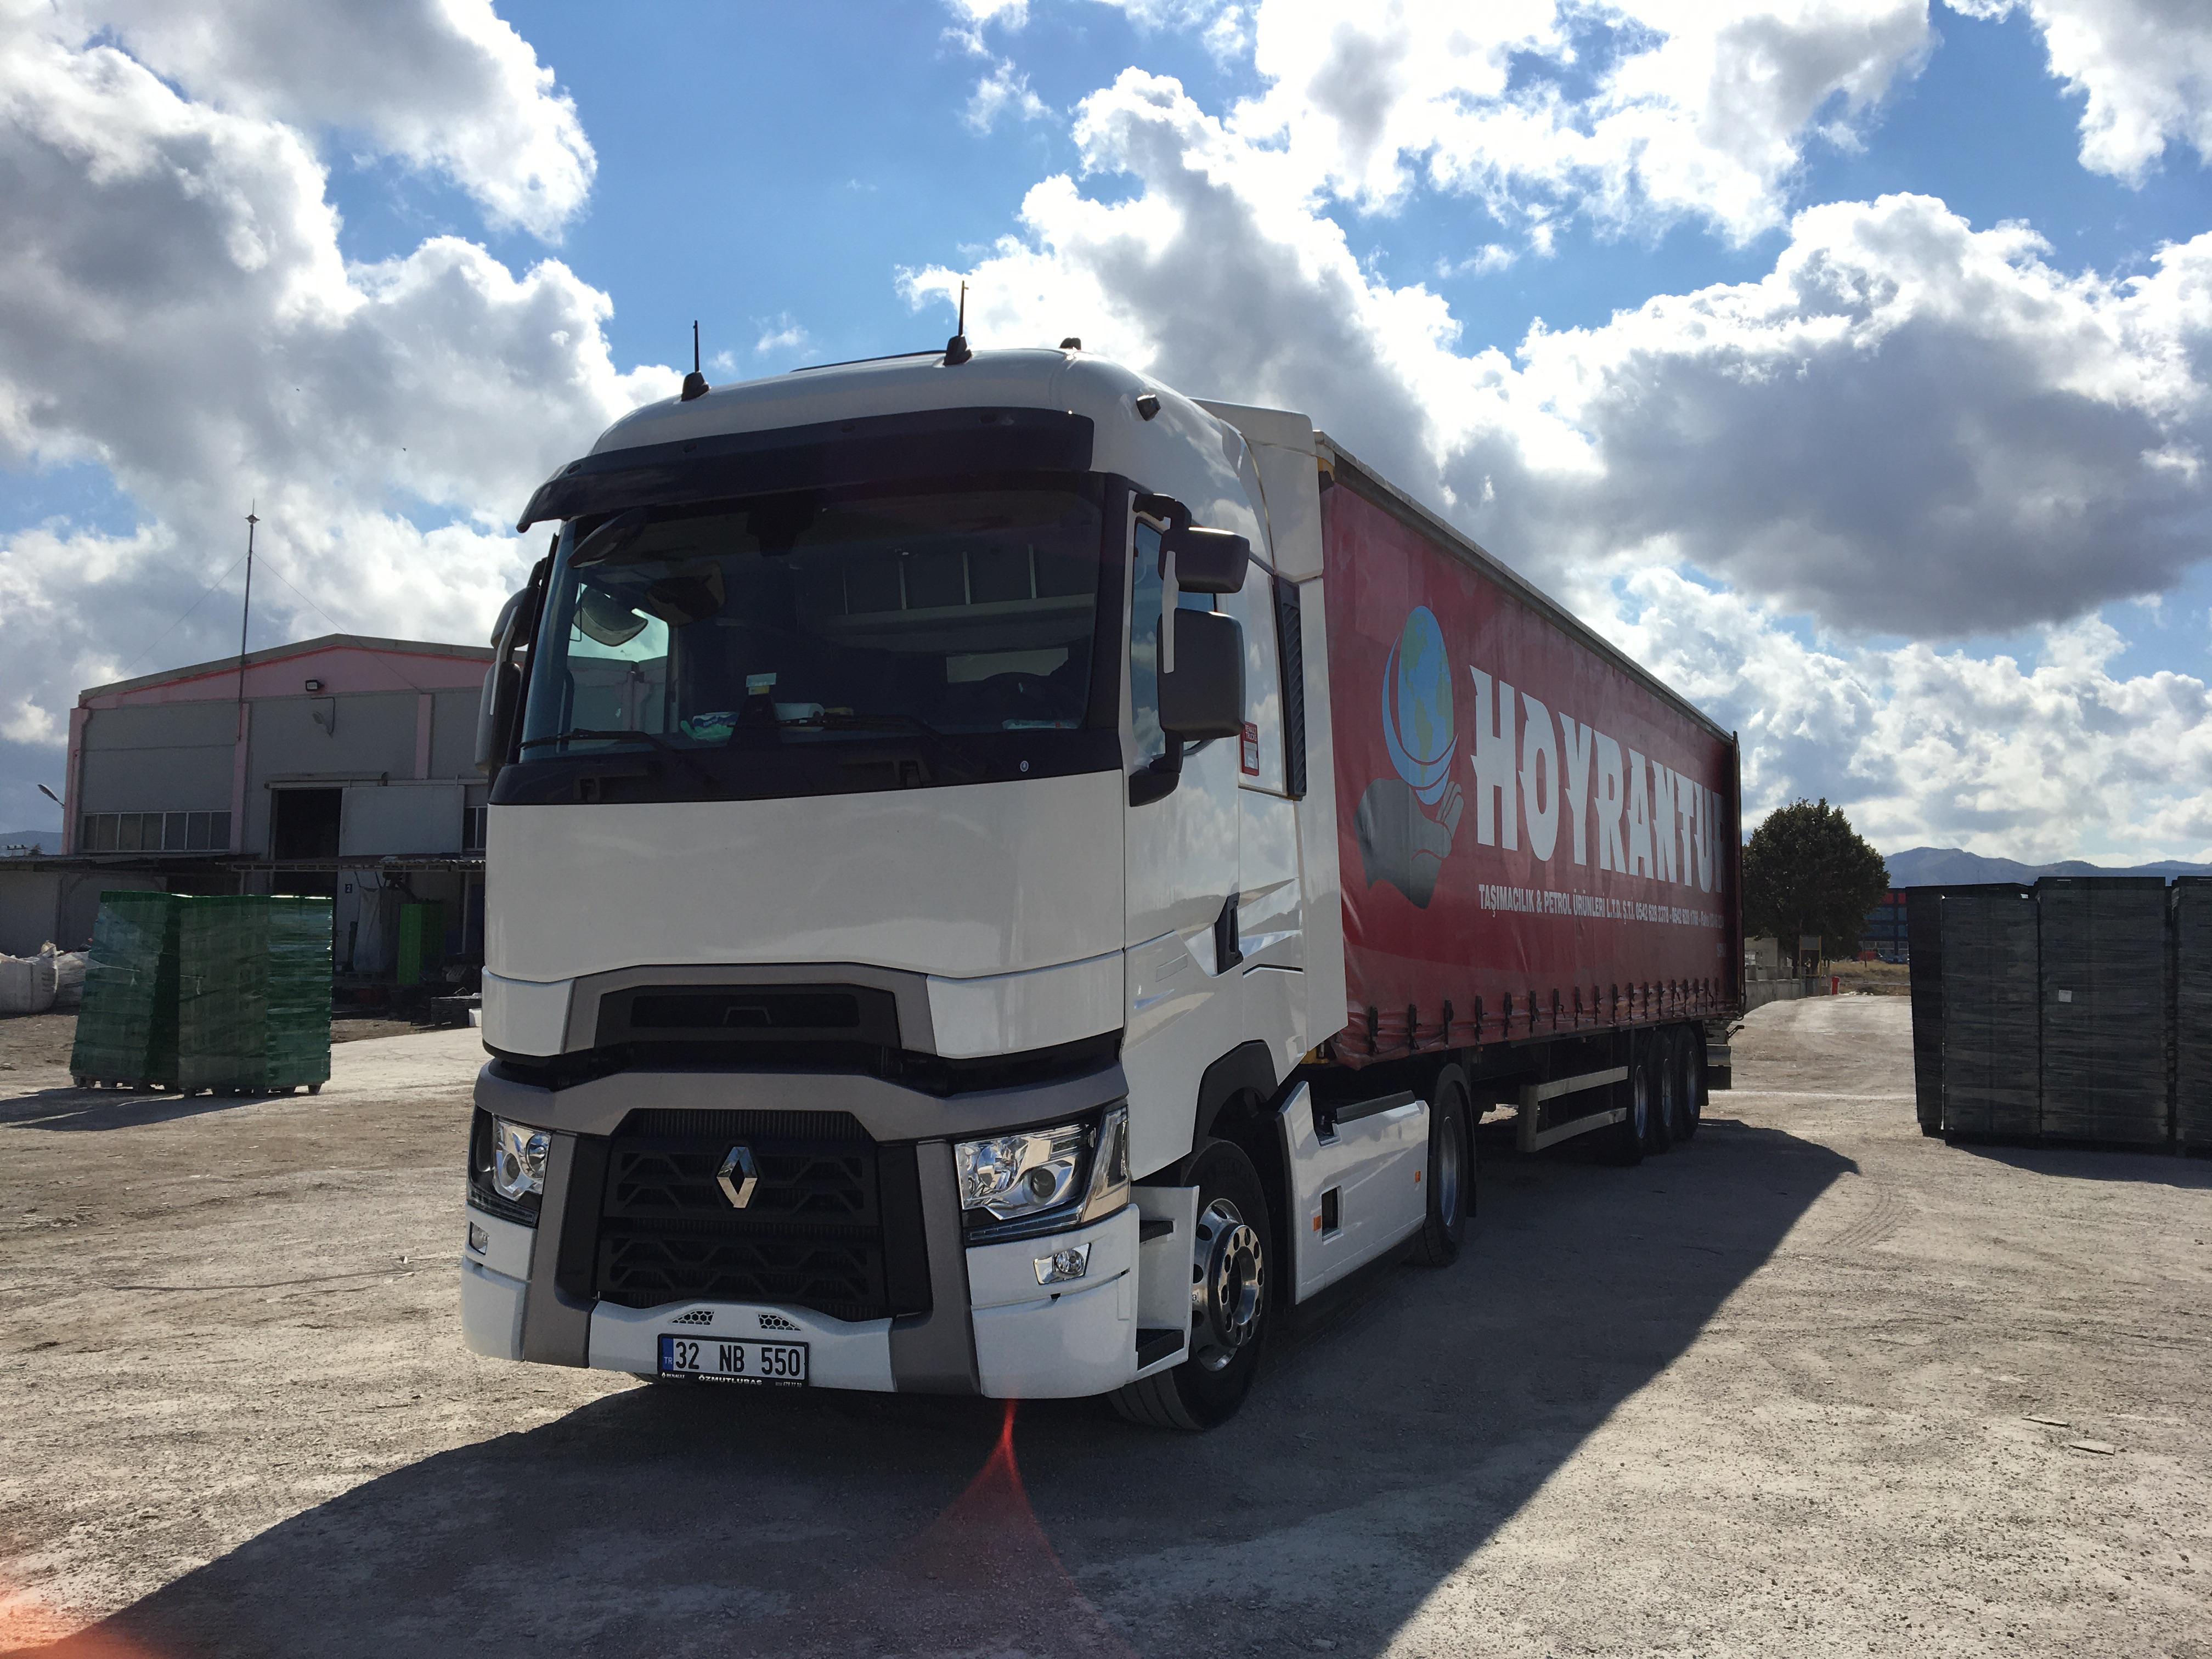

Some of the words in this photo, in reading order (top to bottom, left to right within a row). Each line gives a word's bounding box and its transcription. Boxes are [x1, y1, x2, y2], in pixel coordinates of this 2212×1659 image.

[346, 884, 351, 893] 2
[1479, 884, 1535, 918] TAŞIMACILIK
[1537, 889, 1543, 913] &
[1544, 890, 1572, 915] PETROL
[1572, 888, 1606, 918] ÜRÜNLERİ
[675, 1341, 699, 1369] 32
[719, 1345, 744, 1372] NB
[761, 1347, 800, 1376] 550
